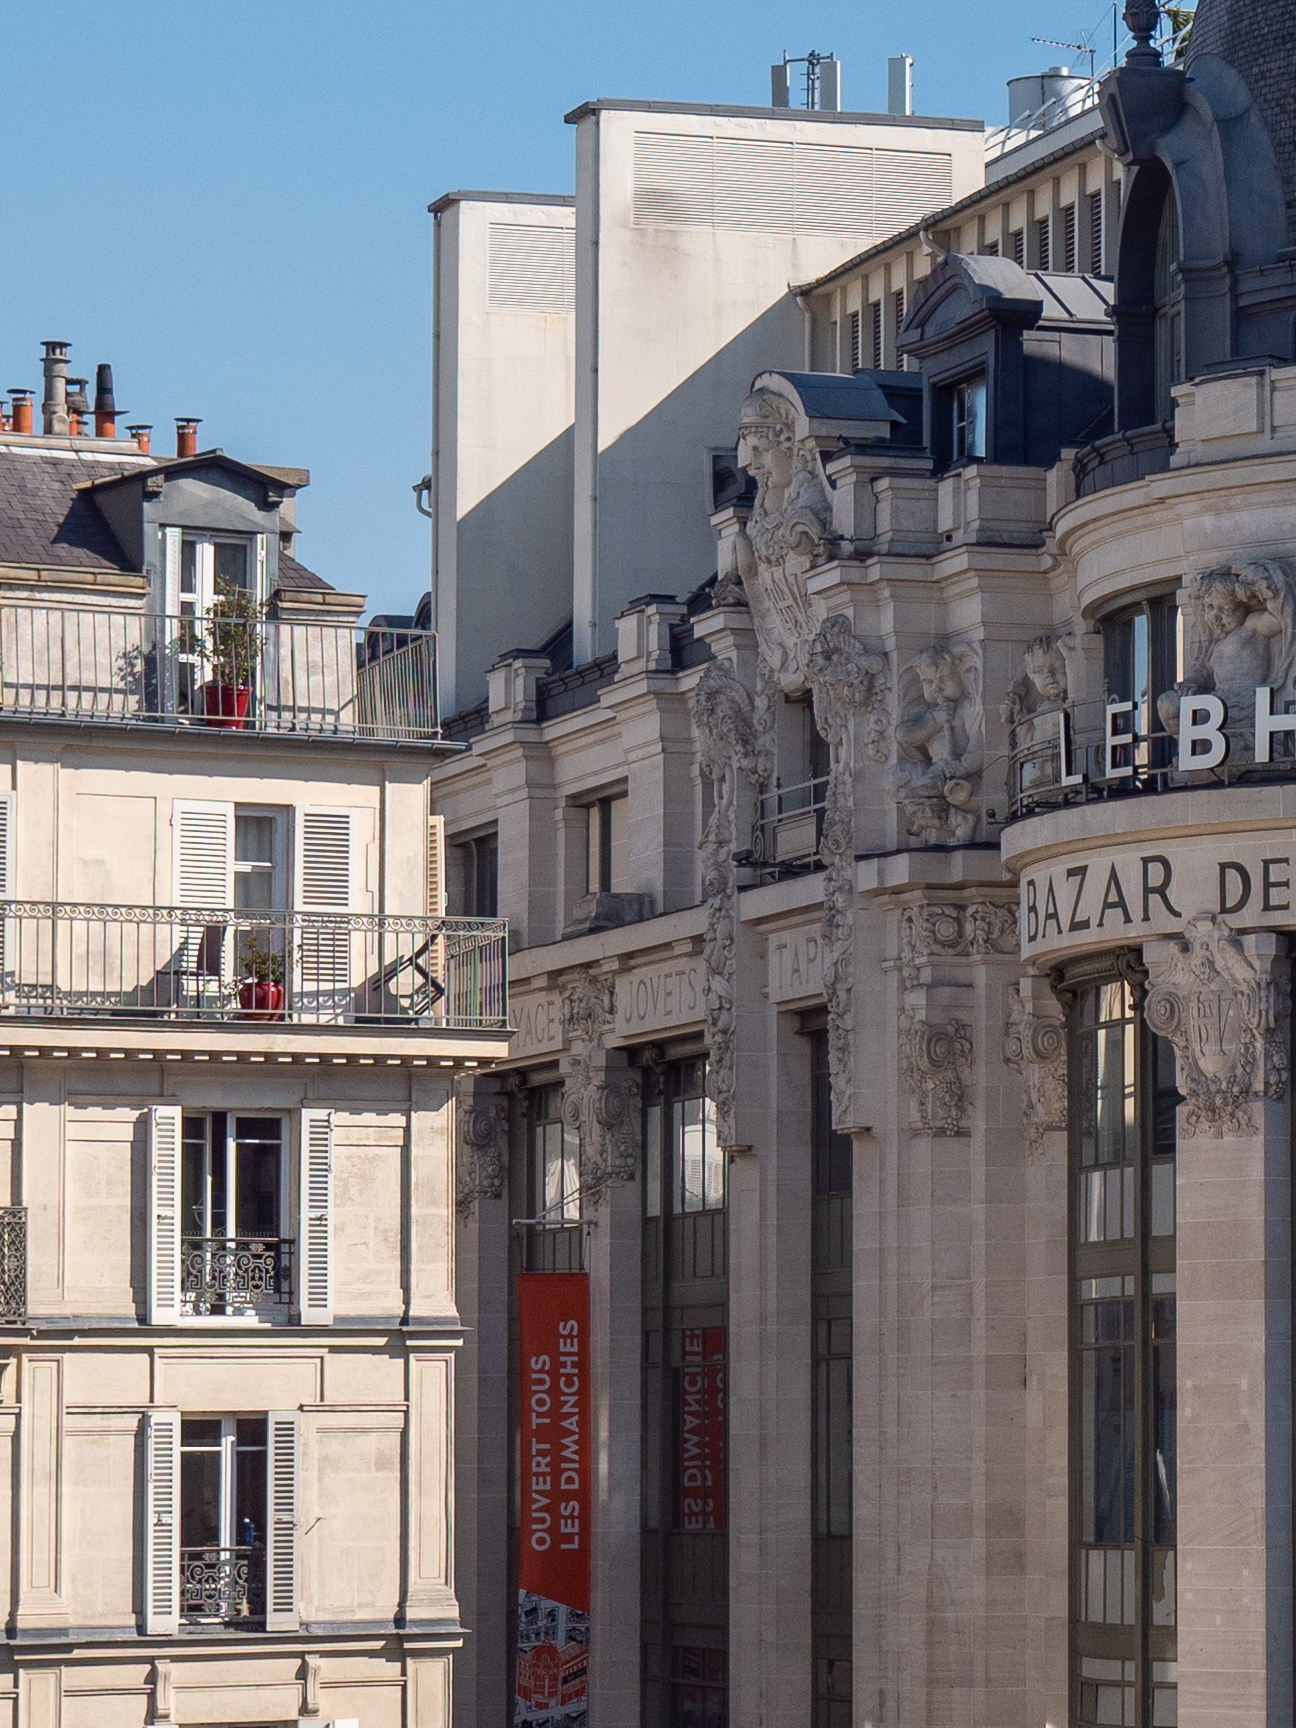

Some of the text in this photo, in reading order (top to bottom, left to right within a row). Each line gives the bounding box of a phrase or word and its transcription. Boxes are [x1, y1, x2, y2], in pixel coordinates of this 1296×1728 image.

[1026, 854, 1183, 943] BAZAR
[1218, 858, 1292, 914] DE
[531, 1353, 551, 1551] OUVERT TOUS
[559, 1318, 580, 1550] LES DIMANCHES
